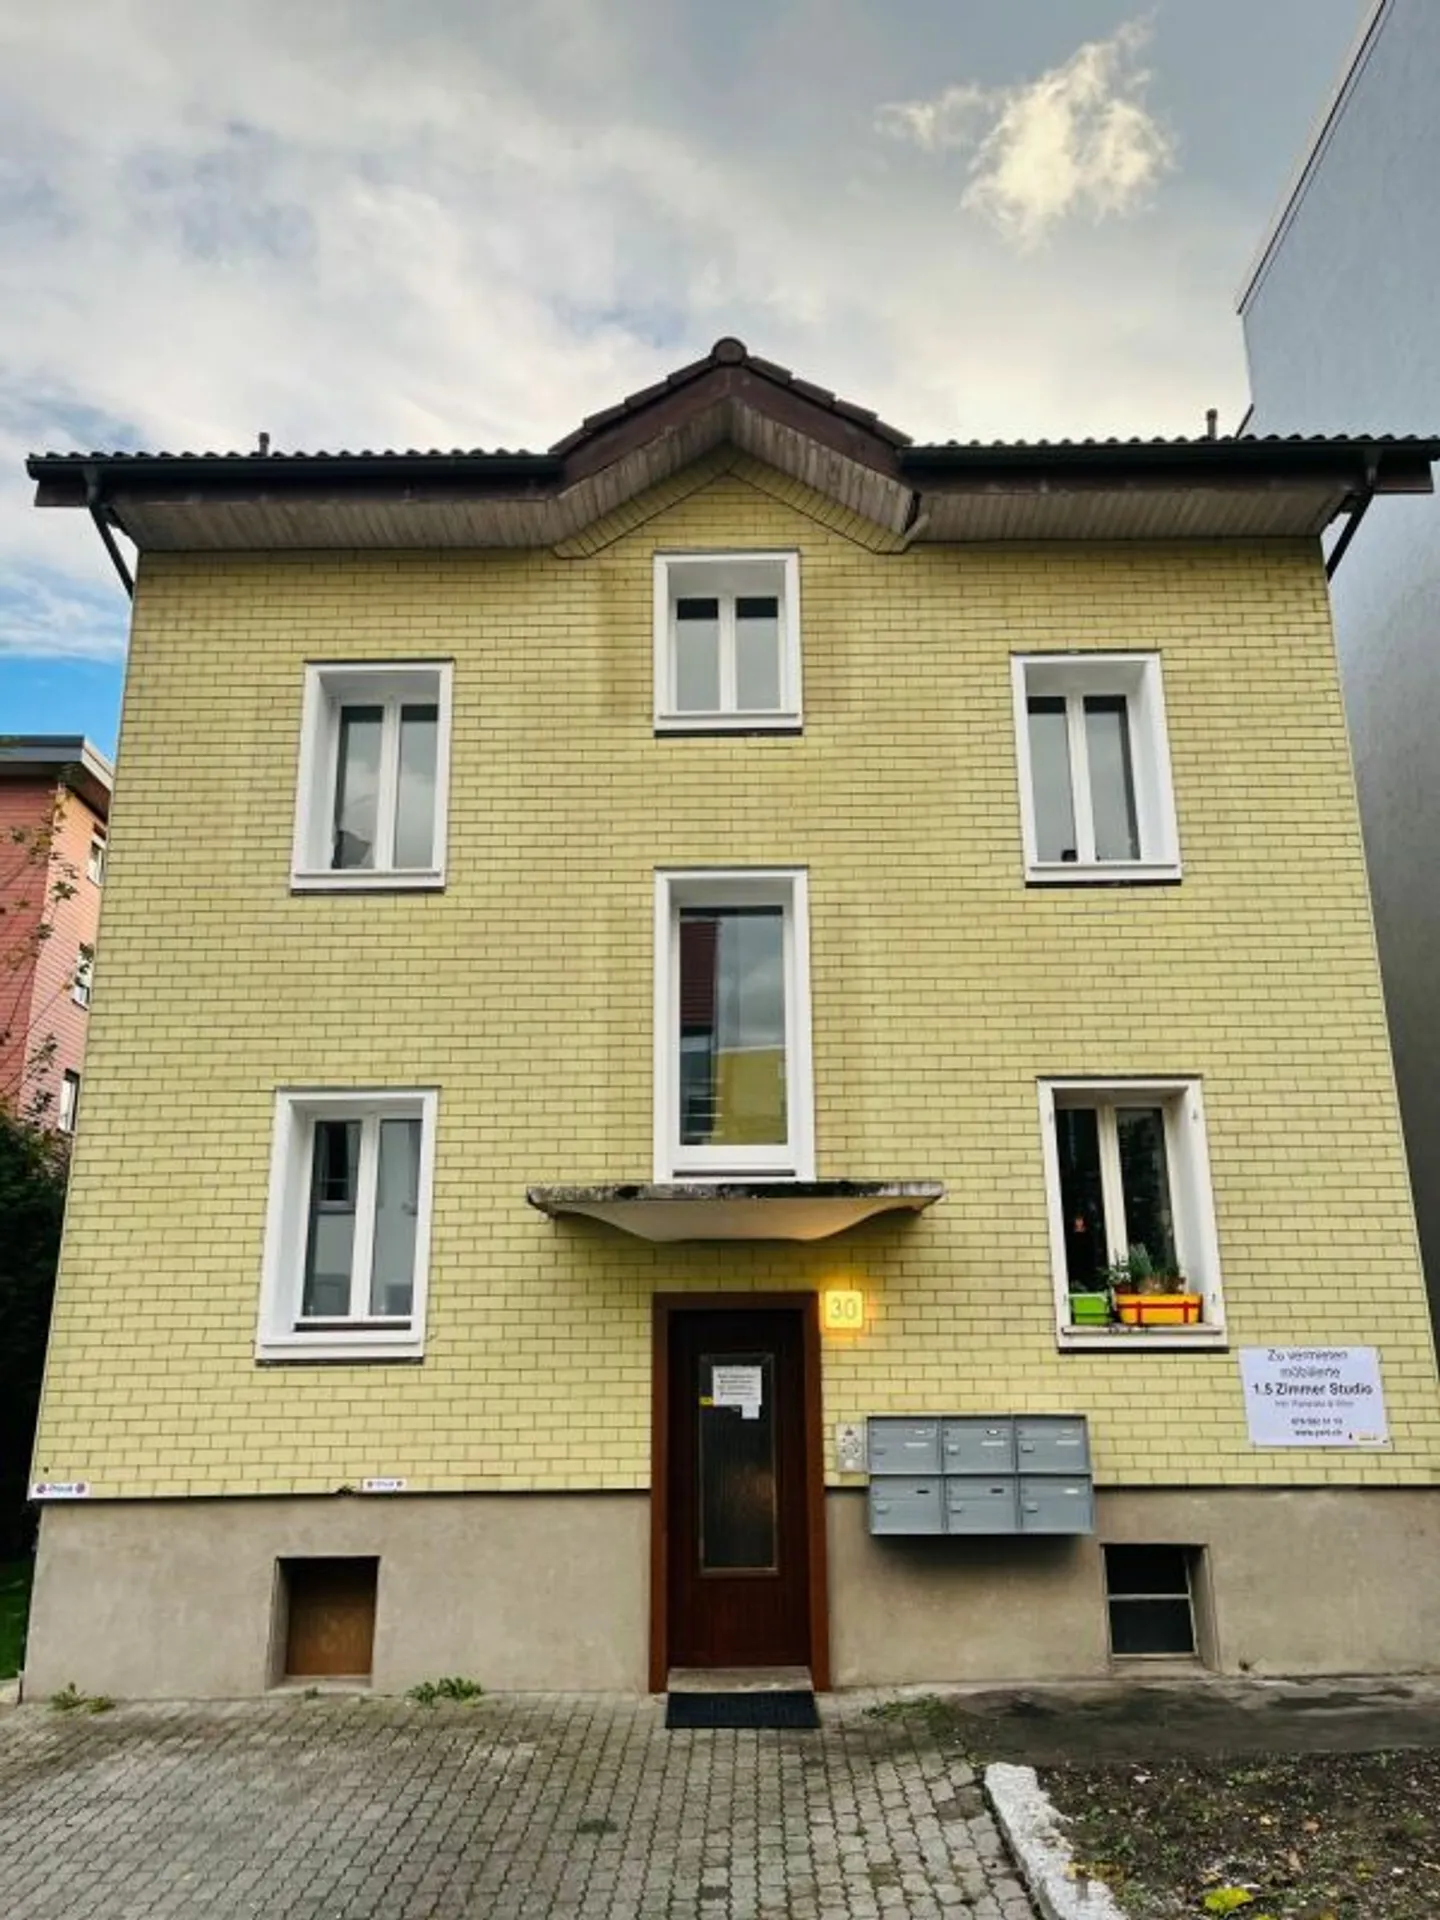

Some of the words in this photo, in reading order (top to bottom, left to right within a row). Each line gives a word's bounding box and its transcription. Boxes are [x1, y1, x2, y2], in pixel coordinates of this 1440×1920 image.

[830, 1296, 858, 1320] 30
[1267, 1349, 1285, 1361] Zu
[1253, 1383, 1273, 1395] 1.5
[1276, 1382, 1326, 1395] Zimmer
[1329, 1382, 1373, 1395] Studio
